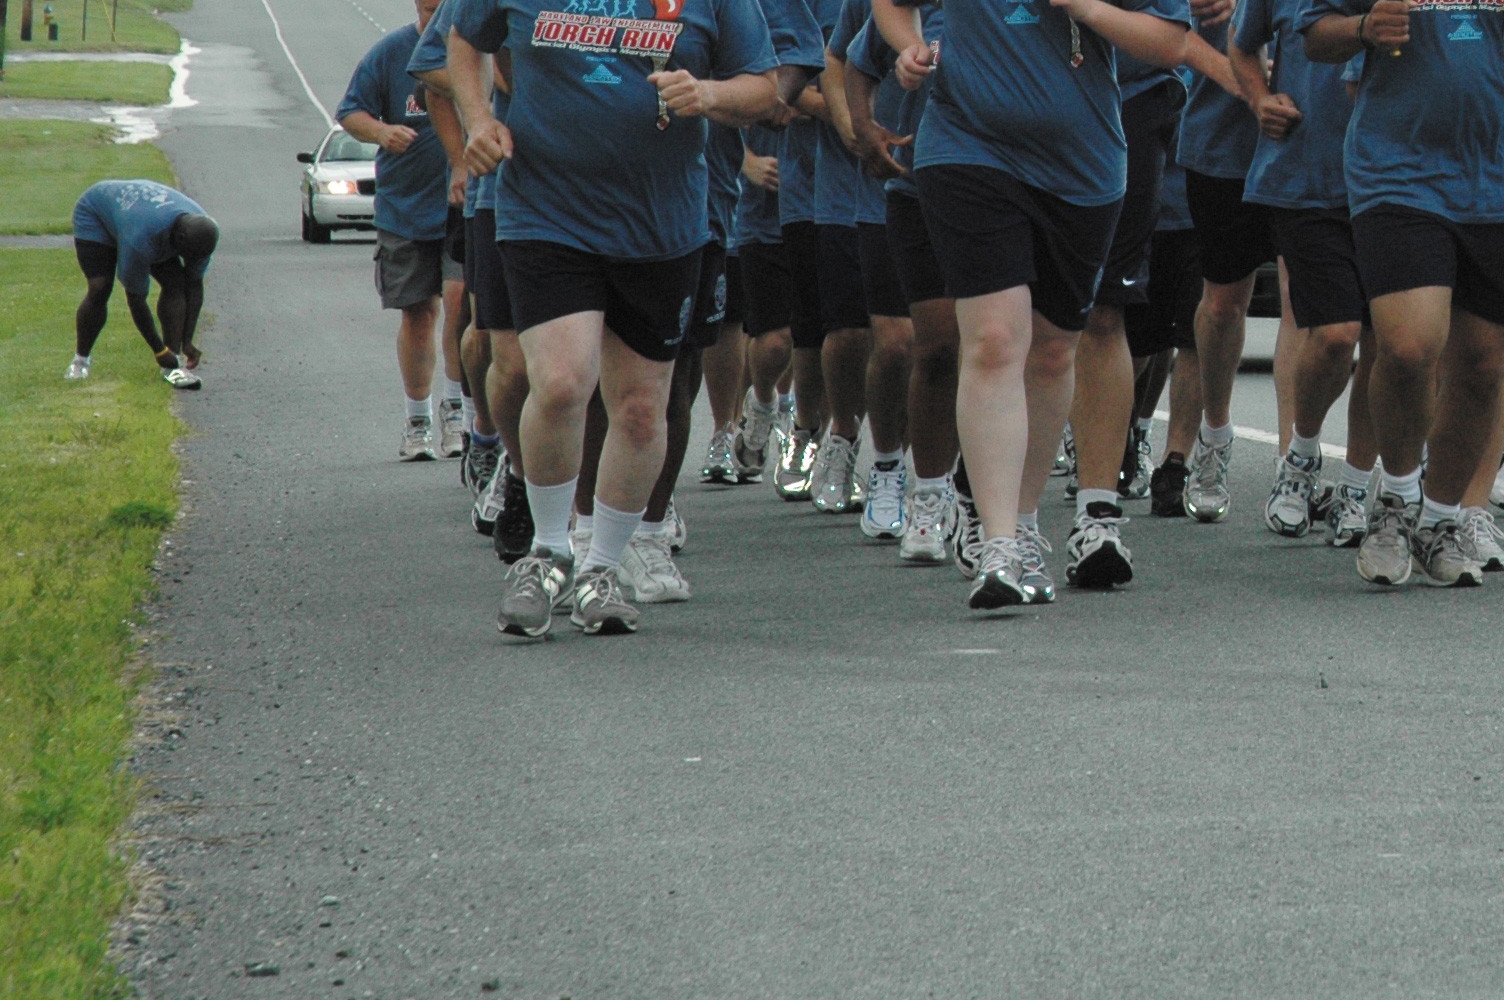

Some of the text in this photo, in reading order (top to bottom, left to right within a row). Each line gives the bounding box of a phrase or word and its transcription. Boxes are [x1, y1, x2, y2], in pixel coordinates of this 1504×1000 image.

[538, 11, 678, 33] MARYLAND LAW ENFORCEMENT
[533, 20, 677, 52] TORCH RUN
